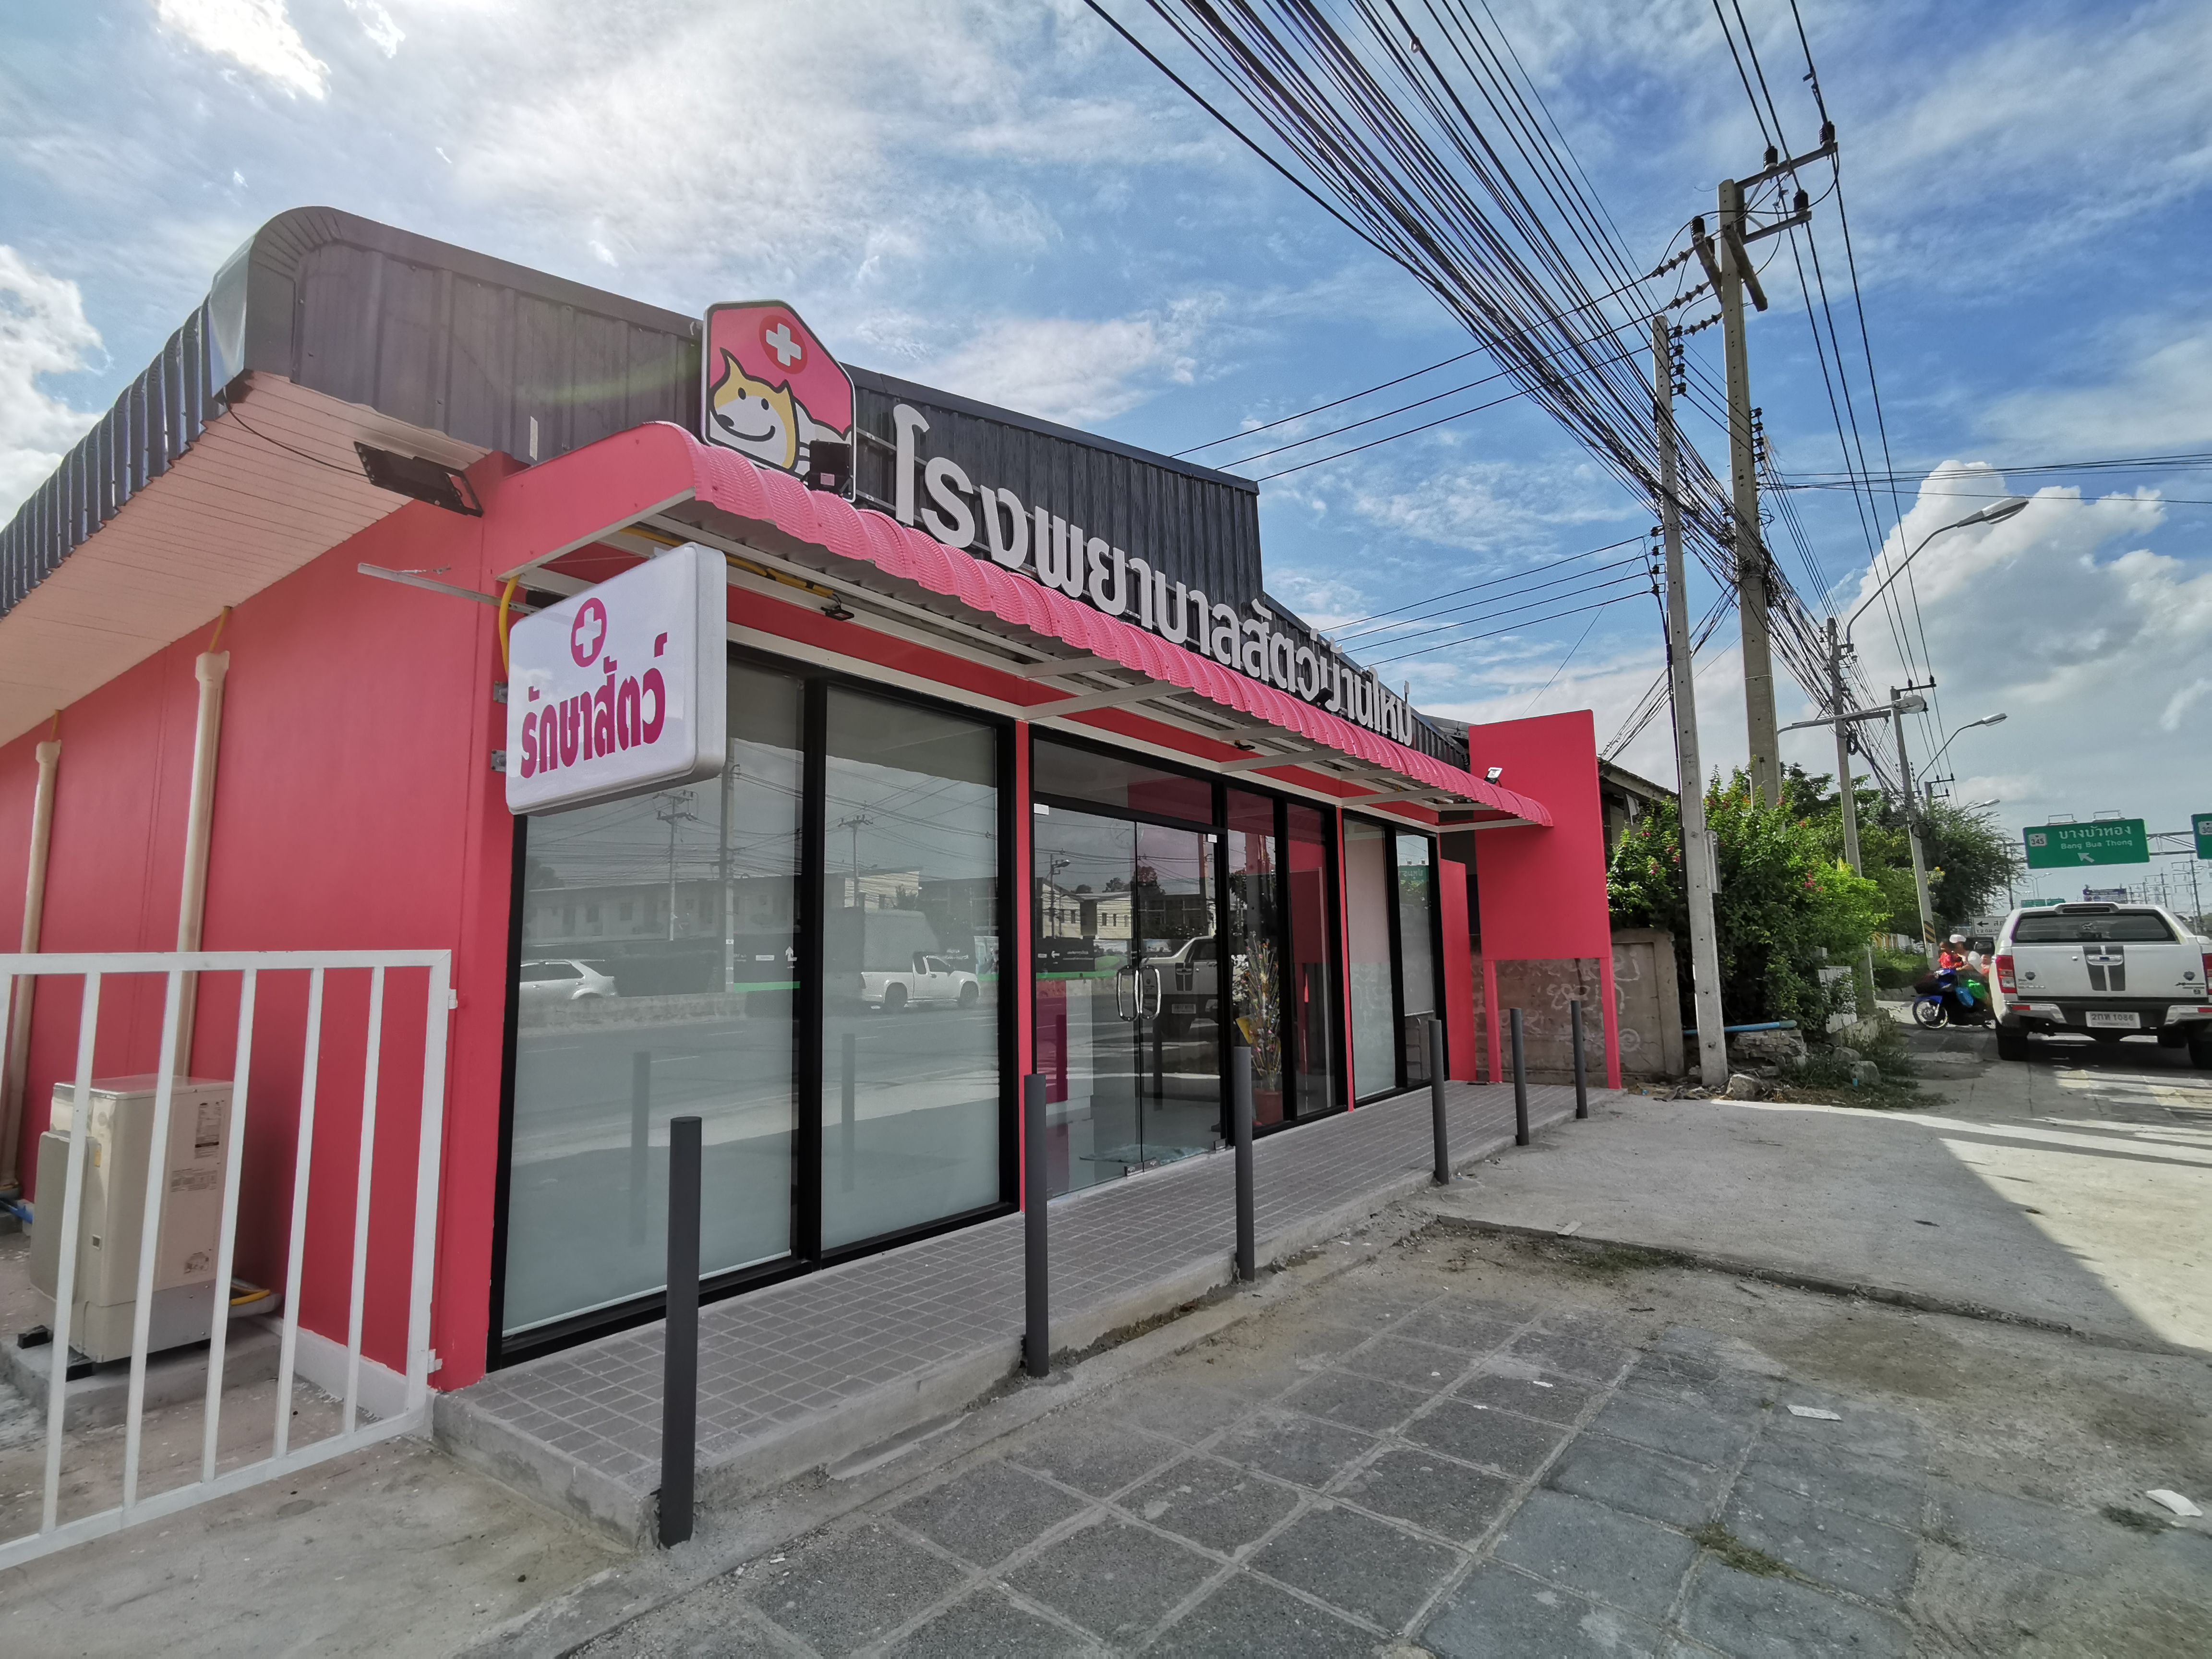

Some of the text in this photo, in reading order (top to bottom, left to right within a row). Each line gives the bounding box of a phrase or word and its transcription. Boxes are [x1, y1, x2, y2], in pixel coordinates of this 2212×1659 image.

[520, 632, 668, 779] รักษาสัตว์
[2059, 825, 2132, 839] บางบัวทอง
